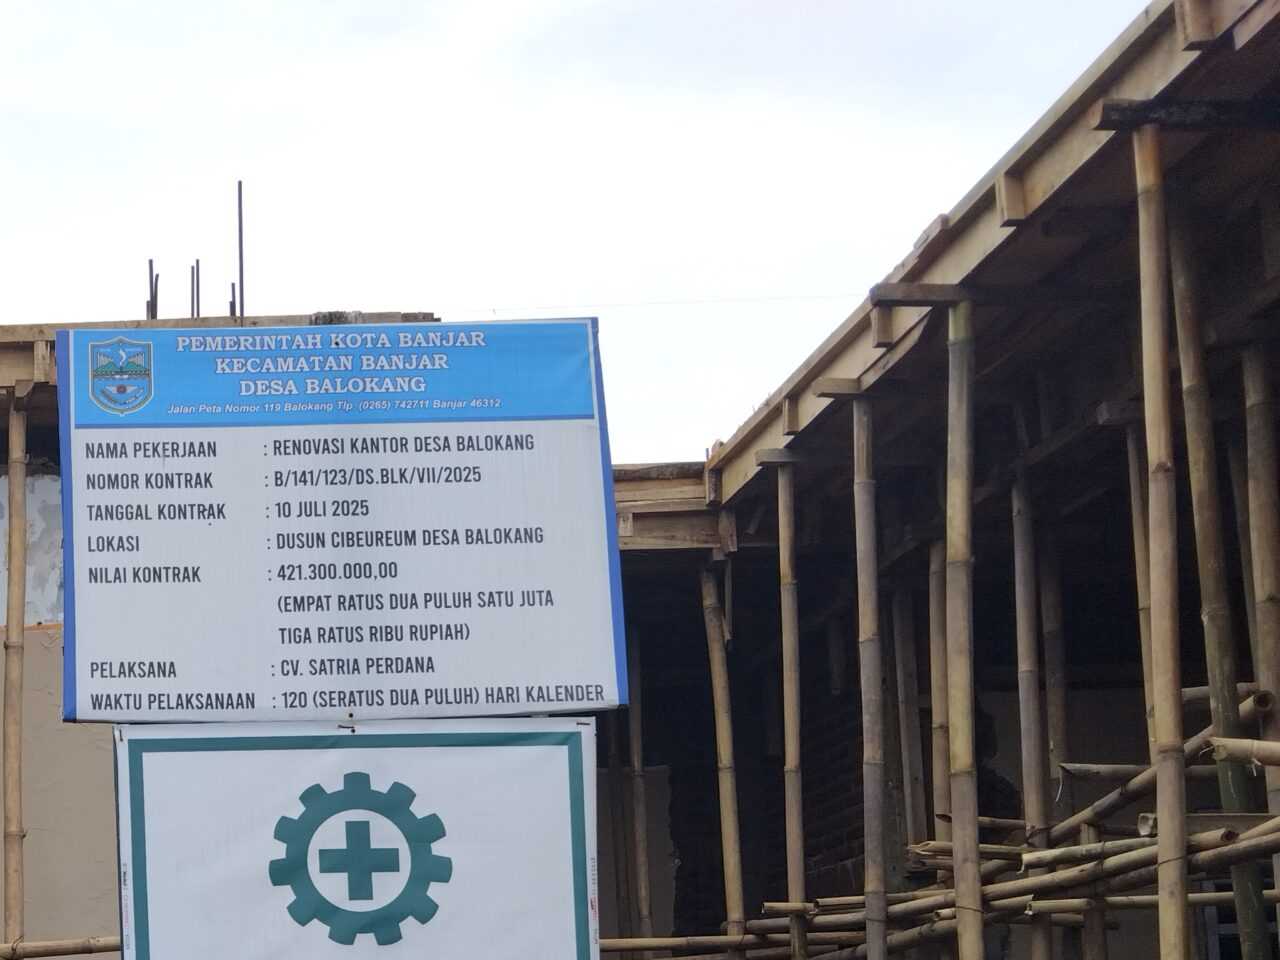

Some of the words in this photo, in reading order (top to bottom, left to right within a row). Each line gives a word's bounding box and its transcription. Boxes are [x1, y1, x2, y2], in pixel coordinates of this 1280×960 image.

[177, 334, 321, 352] PEMERINTAH
[330, 333, 391, 348] KOTA
[399, 331, 486, 347] BANJAR
[216, 355, 353, 374] KECAMATAN
[361, 354, 449, 370] BANJAR
[240, 380, 298, 396] DESA
[306, 376, 426, 394] BALOKANG
[168, 405, 195, 414] Jalan
[225, 404, 259, 413] Nomor
[264, 403, 280, 412] 119
[284, 402, 333, 412] Balokang
[433, 400, 465, 410] Banjar
[85, 442, 129, 459] NAMA
[133, 441, 217, 459] PEKERJAAN
[273, 437, 345, 456] RENOVASI
[350, 436, 409, 454] KANTOR
[413, 435, 452, 453] DESA
[456, 433, 535, 452] BALOKANG
[86, 472, 140, 490] NOMOR
[144, 471, 213, 490] KONTRAK
[274, 466, 482, 488] B/141/123/DS.BLK/VII/2025
[86, 503, 153, 521] TANGGAL
[157, 503, 226, 521] KONTRAK
[274, 501, 292, 518] 10
[296, 500, 327, 518] JULI
[331, 499, 370, 517] 2025
[87, 535, 140, 553] LOKASI
[276, 531, 326, 550] DUSUN
[330, 529, 417, 549] CIBEUREUM
[422, 528, 460, 546] DESA
[465, 526, 544, 545] BALOKANG
[88, 567, 127, 584] NILAI
[132, 566, 201, 584] KONTRAK
[277, 561, 398, 581] 421.300.000,00
[277, 594, 333, 614] (EMPAT
[337, 593, 385, 612] RATUS
[389, 592, 419, 610] DUA
[423, 591, 472, 609] PULUH
[477, 590, 514, 609] SATU
[519, 589, 554, 607] JUTA
[278, 627, 312, 645] TIGA
[317, 625, 364, 644] RATUS
[368, 624, 404, 643] RIBU
[409, 623, 470, 642] RUPIAH)
[90, 661, 177, 679] PELAKSANA
[280, 659, 304, 677] CV.
[308, 657, 361, 676] SATRIA
[365, 656, 435, 675] PERDANA
[90, 693, 142, 711] WAKTU
[147, 692, 256, 711] PELAKSANAAN
[281, 691, 308, 709] 120
[312, 689, 385, 709] (SERATUS
[389, 688, 420, 706] DUA
[424, 687, 480, 705] PULUH)
[485, 686, 520, 704] HARI
[525, 684, 605, 703] KALENDER
